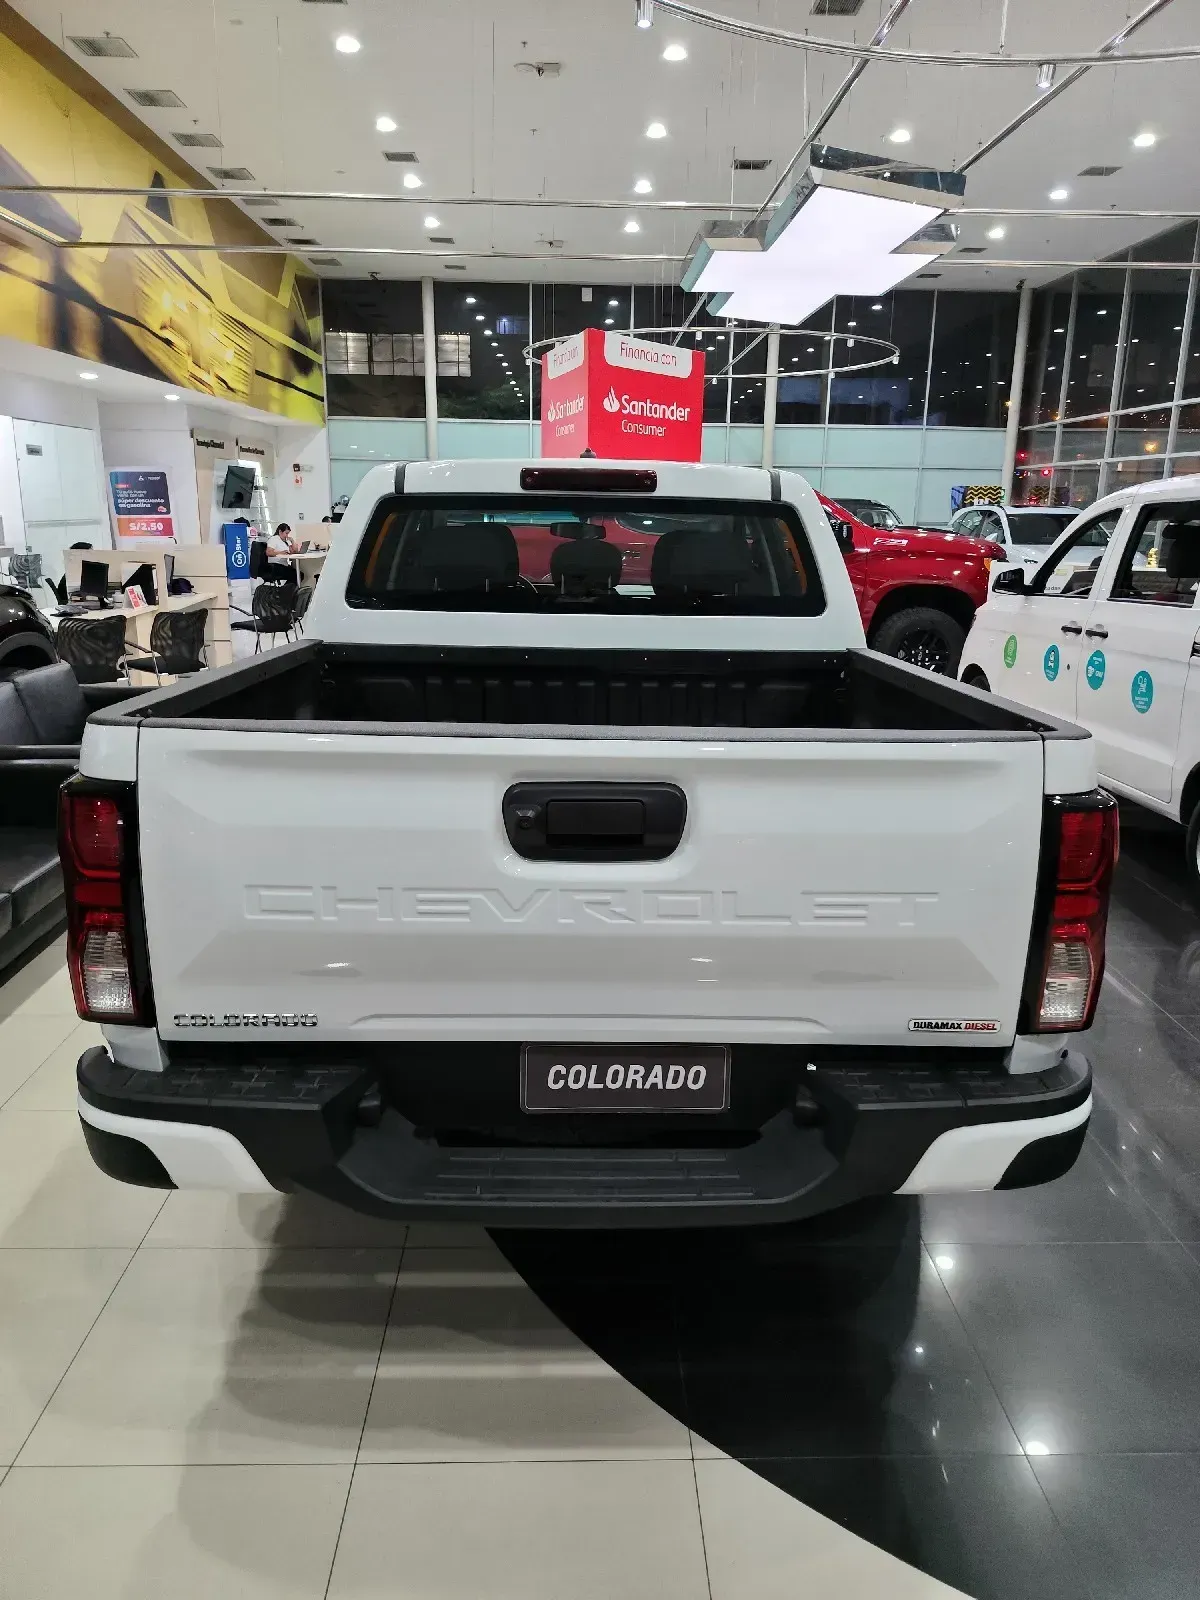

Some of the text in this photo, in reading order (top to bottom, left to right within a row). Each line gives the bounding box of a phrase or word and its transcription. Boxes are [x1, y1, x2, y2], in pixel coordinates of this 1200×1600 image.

[619, 341, 677, 367] Financia con
[556, 393, 585, 420] Santander
[621, 394, 691, 422] Santander
[621, 419, 666, 438] Consumer
[244, 884, 940, 926] CHEVROLET
[173, 1013, 319, 1027] COLORADO
[913, 1021, 998, 1031] DURAMAX DIESEL
[547, 1064, 707, 1090] COLORADO
